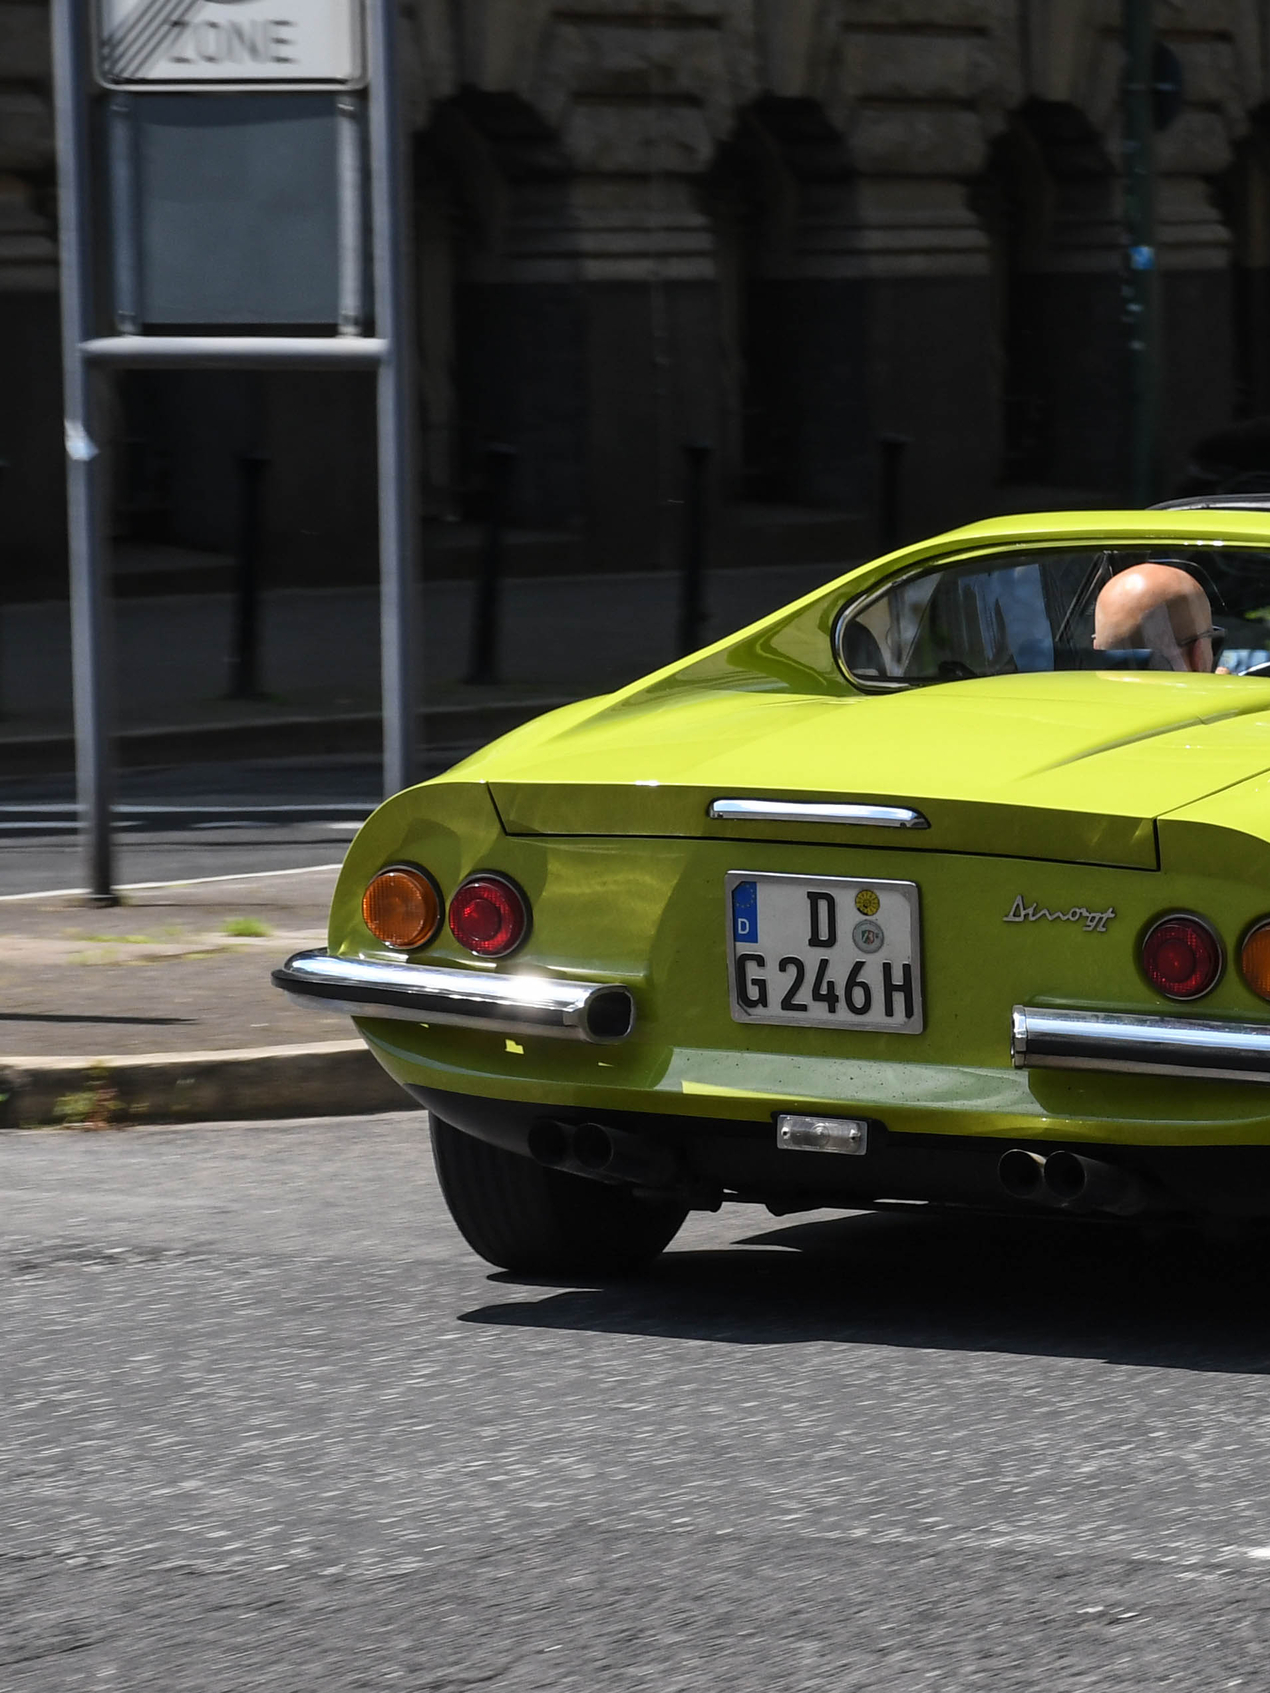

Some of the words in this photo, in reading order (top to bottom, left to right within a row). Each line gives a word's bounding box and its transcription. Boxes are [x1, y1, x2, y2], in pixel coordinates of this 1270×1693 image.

[166, 18, 298, 65] ZONE
[738, 918, 750, 934] D
[806, 890, 837, 948] D
